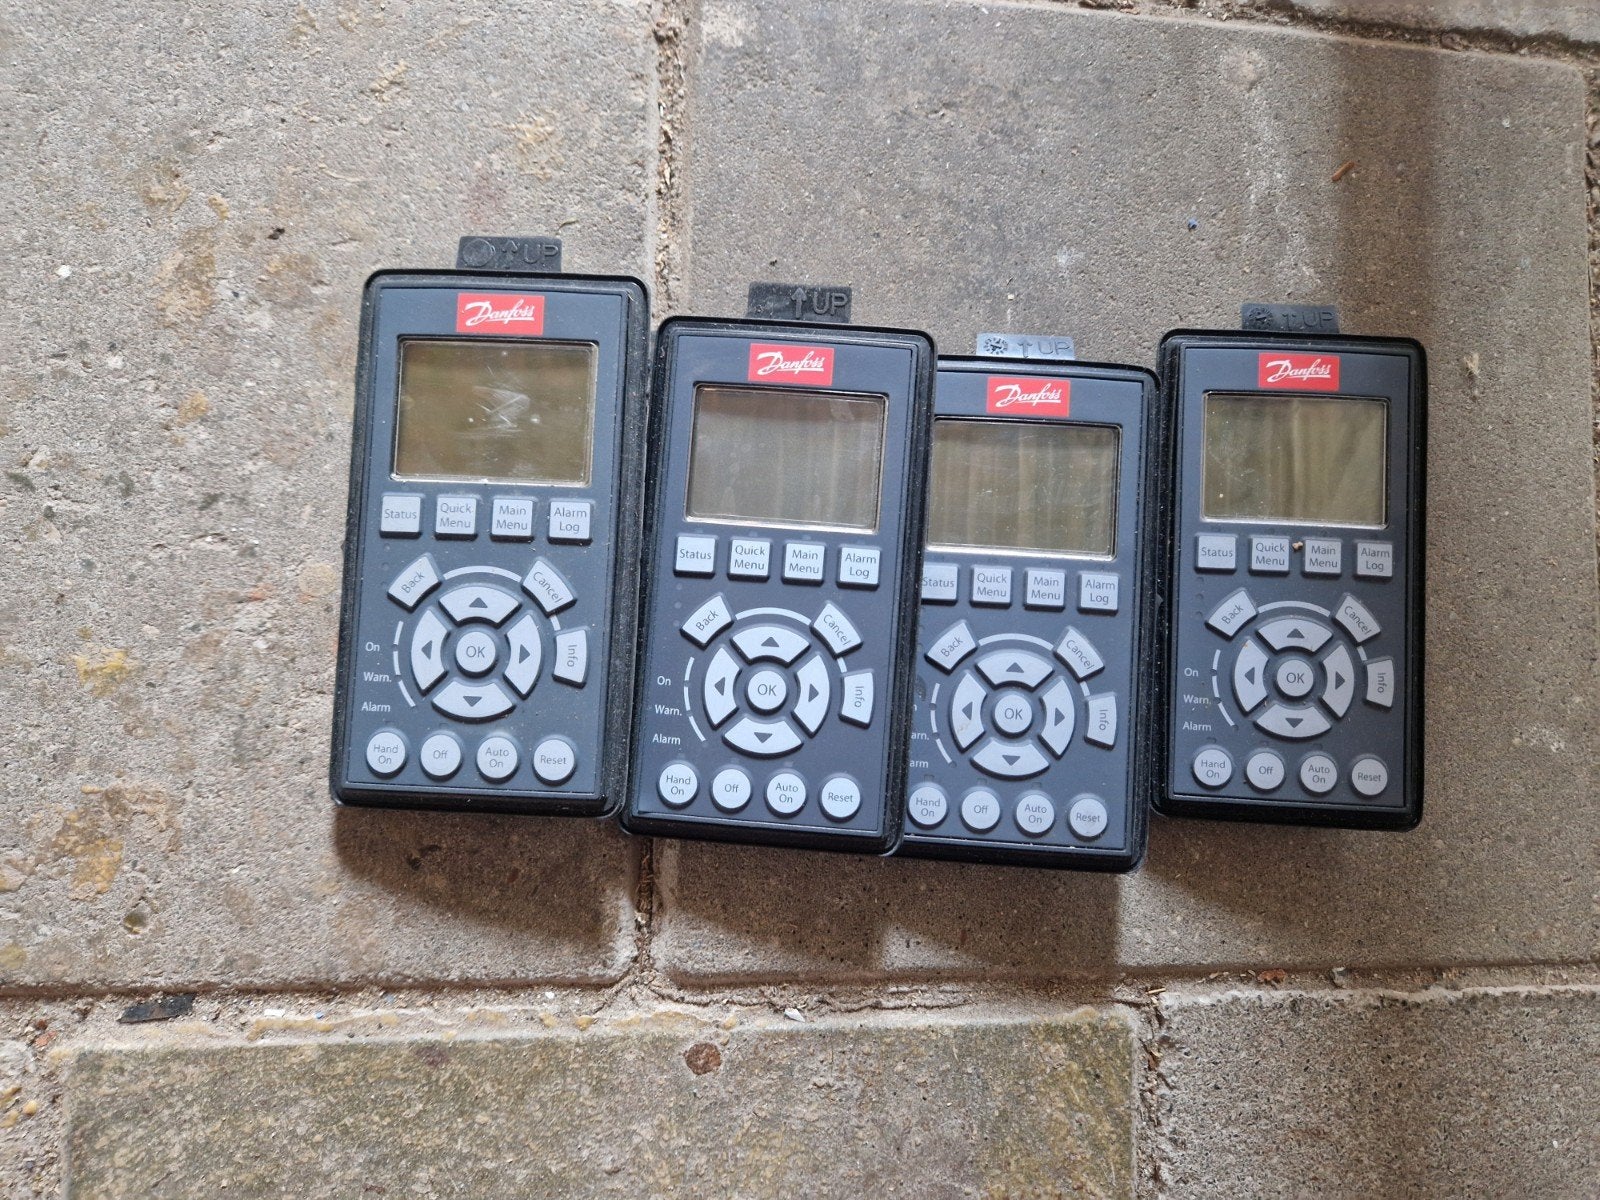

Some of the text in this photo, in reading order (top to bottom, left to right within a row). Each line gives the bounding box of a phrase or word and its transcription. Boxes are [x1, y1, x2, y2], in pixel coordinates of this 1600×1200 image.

[523, 244, 559, 264] UP
[813, 292, 848, 314] UP
[466, 301, 535, 327] Danfoss
[1302, 312, 1333, 328] UP
[1038, 340, 1071, 354] UP
[757, 351, 824, 375] Danfoss
[1266, 358, 1331, 383] Danfoss
[995, 384, 1061, 408] Danfoss
[384, 508, 417, 520] Status
[440, 502, 471, 515] Quick
[499, 505, 526, 516] Main
[554, 508, 586, 518] Alarm
[440, 517, 471, 528] Menu
[497, 519, 527, 530] Menu
[560, 522, 580, 534] Log
[735, 545, 765, 557] Quick
[1201, 546, 1233, 557] Status
[1256, 542, 1285, 554] Quick
[1311, 546, 1336, 556] Main
[1361, 547, 1390, 558] Alarm
[679, 549, 711, 559] Status
[792, 550, 818, 560] Main
[845, 553, 877, 564] Alarm
[734, 558, 764, 570] Menu
[1256, 556, 1285, 566] Menu
[1309, 558, 1337, 568] Menu
[1366, 561, 1384, 572] Log
[789, 563, 819, 574] Menu
[849, 567, 869, 578] Log
[402, 571, 425, 593] Back
[977, 573, 1007, 584] Quick
[1034, 577, 1059, 587] Main
[532, 571, 563, 603] Cancel
[1085, 580, 1115, 590] Alarm
[977, 587, 1007, 597] Menu
[1032, 590, 1060, 600] Menu
[1090, 592, 1109, 604] Log
[1222, 604, 1244, 624] Back
[696, 610, 719, 631] Back
[1344, 605, 1371, 635] Cancel
[823, 614, 851, 645] Cancel
[365, 642, 379, 652] On
[466, 645, 485, 658] OK
[941, 637, 963, 656] Back
[567, 645, 576, 667] Info
[1067, 640, 1095, 669] Cancel
[364, 672, 391, 683] Warn.
[1184, 667, 1198, 677] On
[657, 676, 671, 686] On
[1286, 672, 1304, 684] OK
[1377, 672, 1386, 693] Info
[757, 684, 776, 695] OK
[854, 686, 864, 707] Info
[361, 702, 391, 713] Alarm
[655, 705, 682, 715] Warn.
[1004, 708, 1022, 719] OK
[1098, 709, 1108, 730] Info
[1183, 722, 1211, 732] Alarm
[652, 734, 681, 745] Alarm
[910, 732, 929, 740] arn.
[373, 743, 398, 754] Hand
[433, 749, 447, 759] Off
[485, 747, 509, 757] Auto
[378, 755, 392, 765] On
[490, 758, 503, 768] On
[540, 755, 566, 765] Reset
[909, 760, 929, 769] arm
[1201, 759, 1226, 769] Hand
[1207, 769, 1220, 779] On
[1259, 766, 1273, 775] Off
[1308, 764, 1330, 774] Auto
[666, 775, 691, 785] Hand
[1312, 774, 1326, 784] On
[1358, 772, 1381, 782] Reset
[670, 785, 684, 795] On
[724, 783, 738, 793] Off
[775, 783, 798, 792] Auto
[779, 793, 793, 803] On
[828, 792, 853, 802] Reset
[916, 797, 940, 807] Hand
[921, 807, 935, 817] On
[974, 805, 988, 814] Off
[1025, 804, 1047, 814] Auto
[1029, 814, 1042, 824] On
[1076, 813, 1101, 823] Reset
